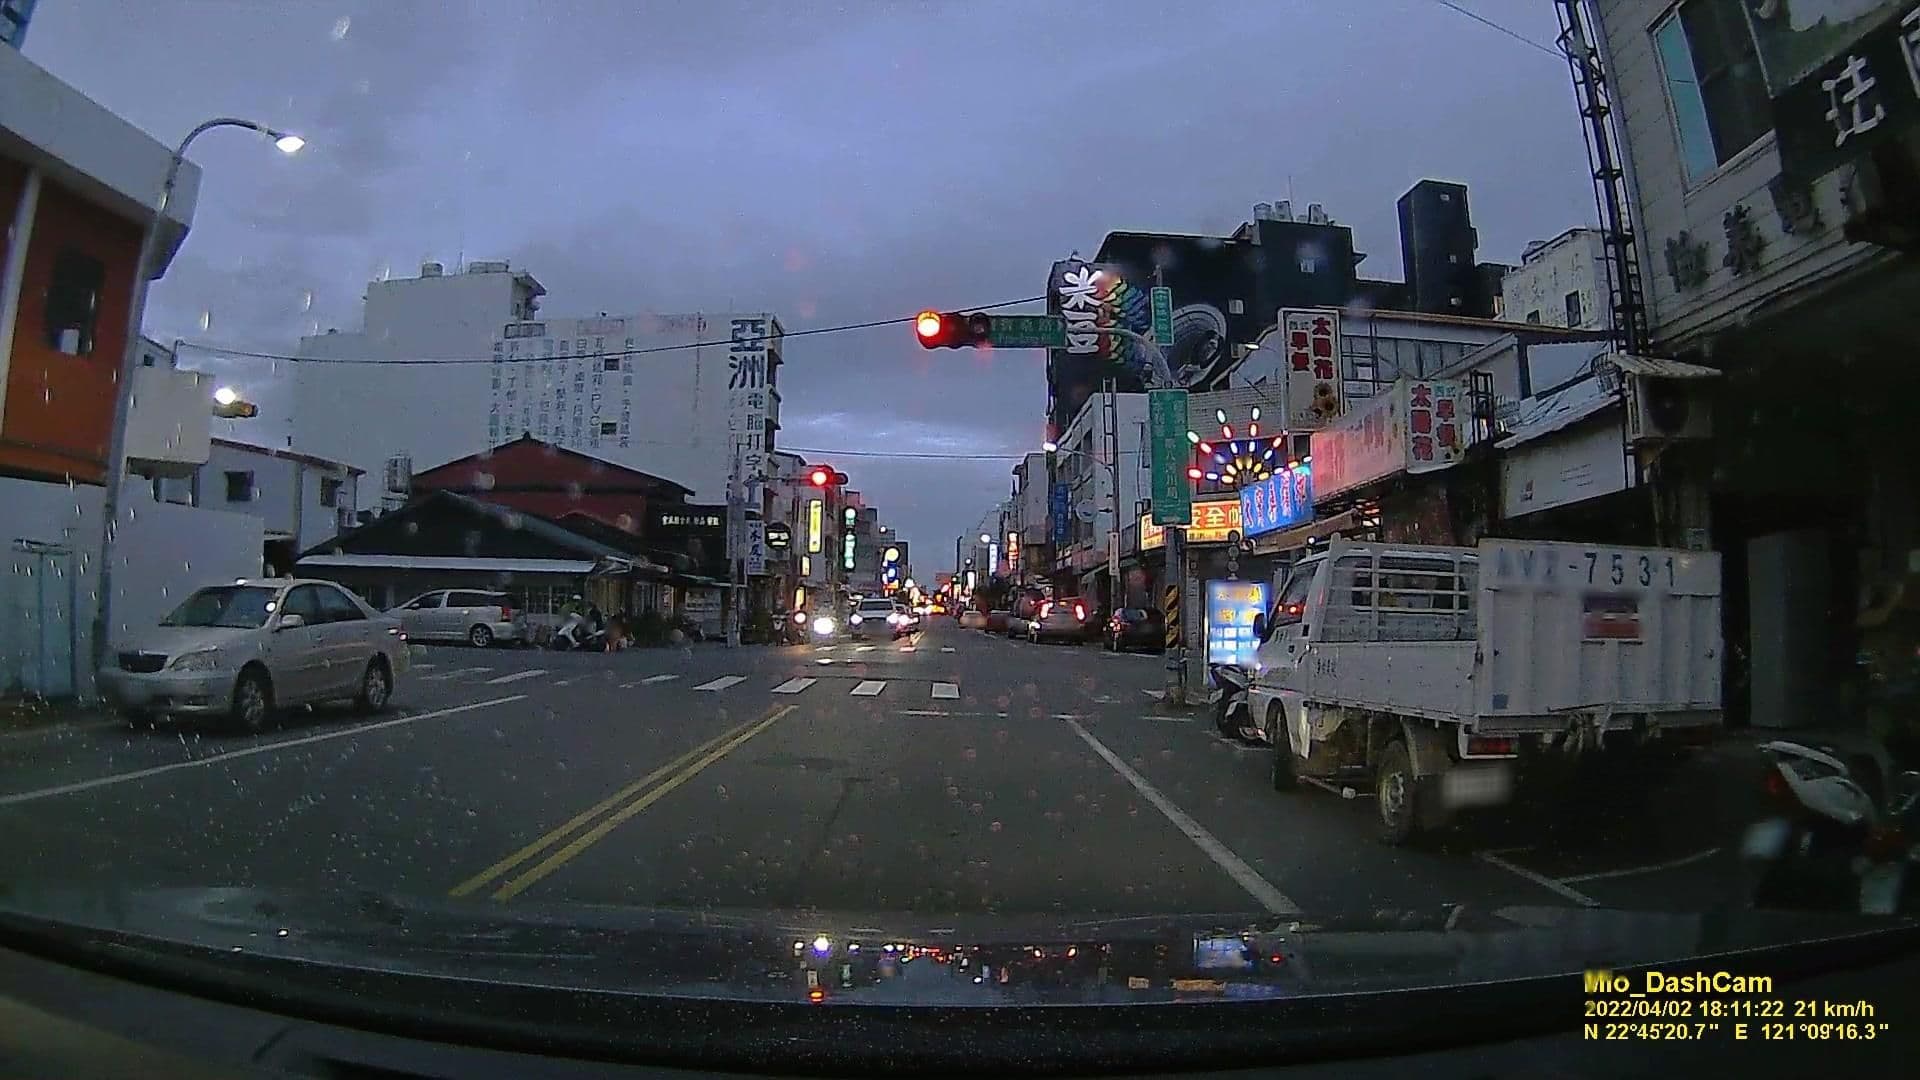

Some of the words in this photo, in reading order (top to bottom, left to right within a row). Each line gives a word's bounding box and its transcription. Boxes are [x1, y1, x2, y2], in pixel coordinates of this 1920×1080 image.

[728, 319, 766, 390] 亞洲
[1312, 317, 1334, 380] 太花
[744, 393, 764, 508] 電腦打字
[1411, 384, 1433, 461] 太花
